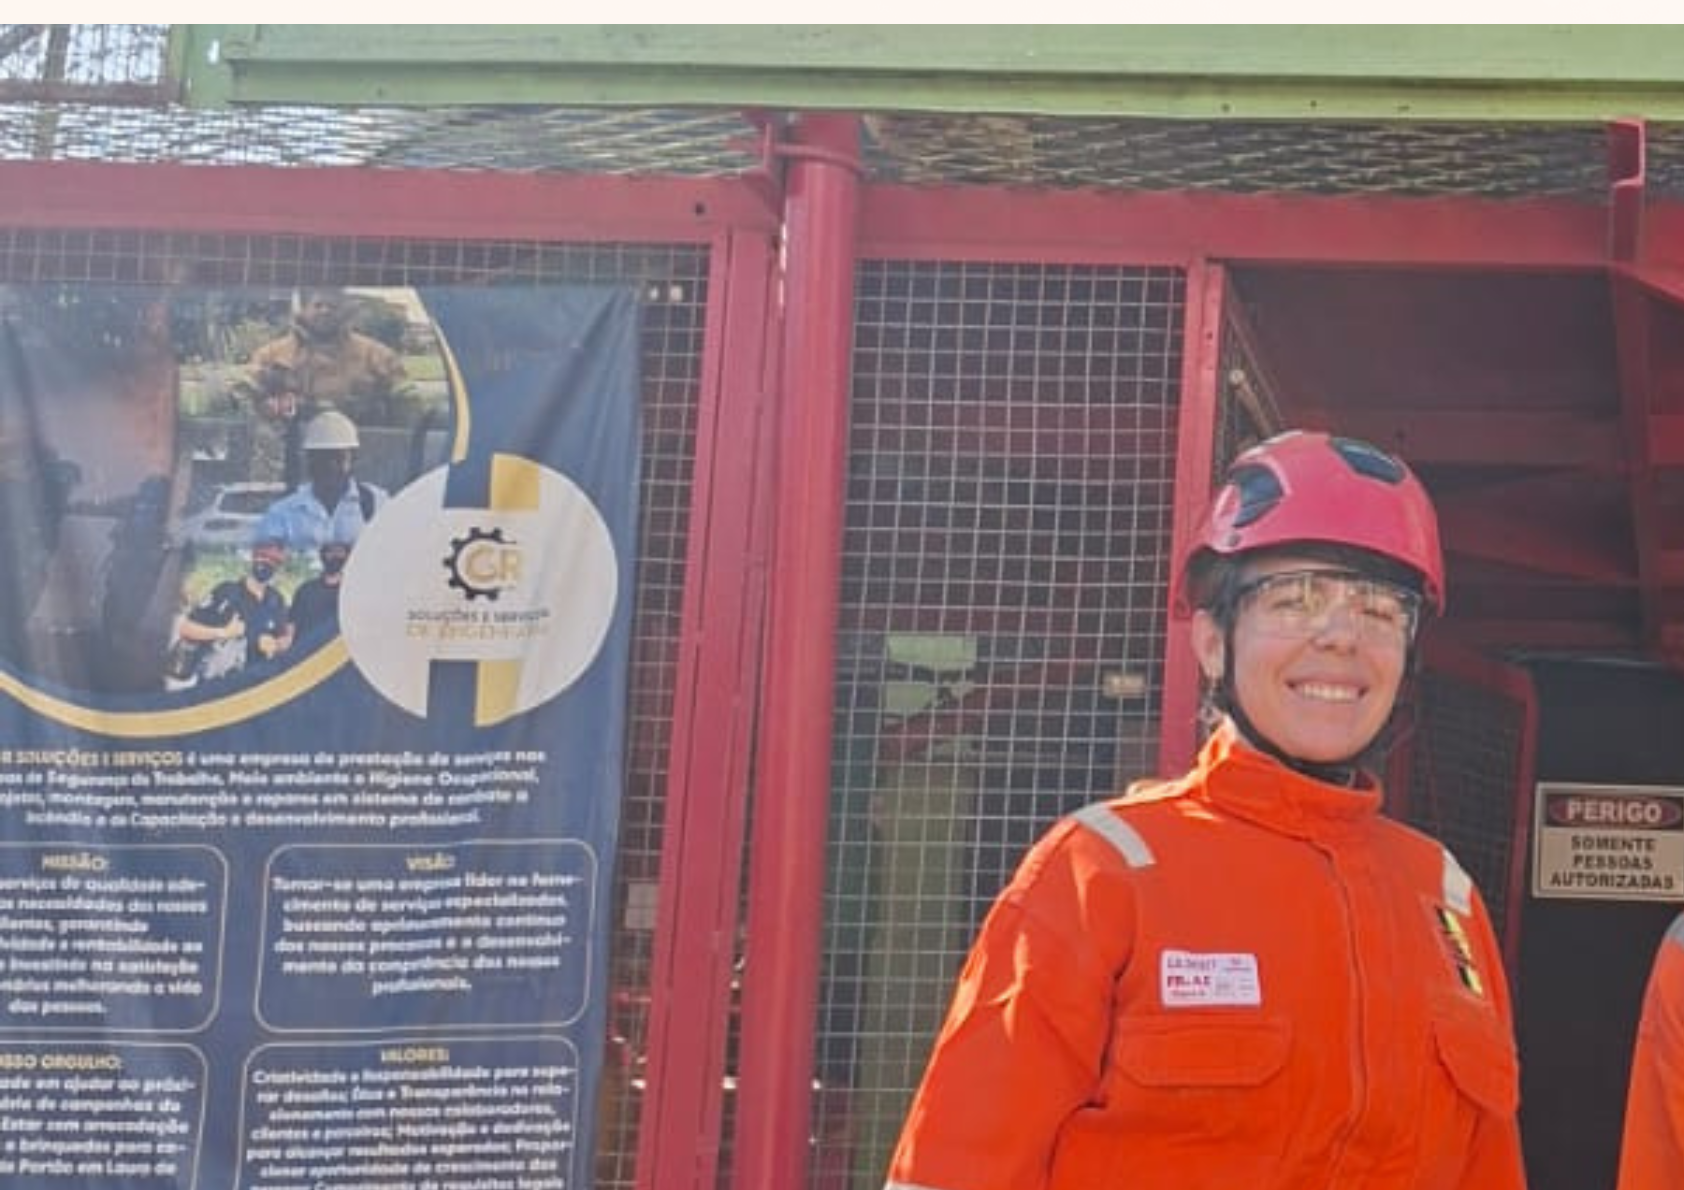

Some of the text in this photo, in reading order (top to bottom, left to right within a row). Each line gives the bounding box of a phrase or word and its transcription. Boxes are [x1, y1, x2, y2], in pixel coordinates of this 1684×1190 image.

[201, 753, 236, 765] uma
[240, 753, 310, 769] empresa
[339, 750, 423, 768] prestação
[272, 771, 349, 785] ambiente
[1568, 799, 1663, 822] PERIGO
[1571, 835, 1657, 851] SOMENTE
[1573, 855, 1654, 870] PESSOAS
[1550, 871, 1674, 890] AUTORIZADAS
